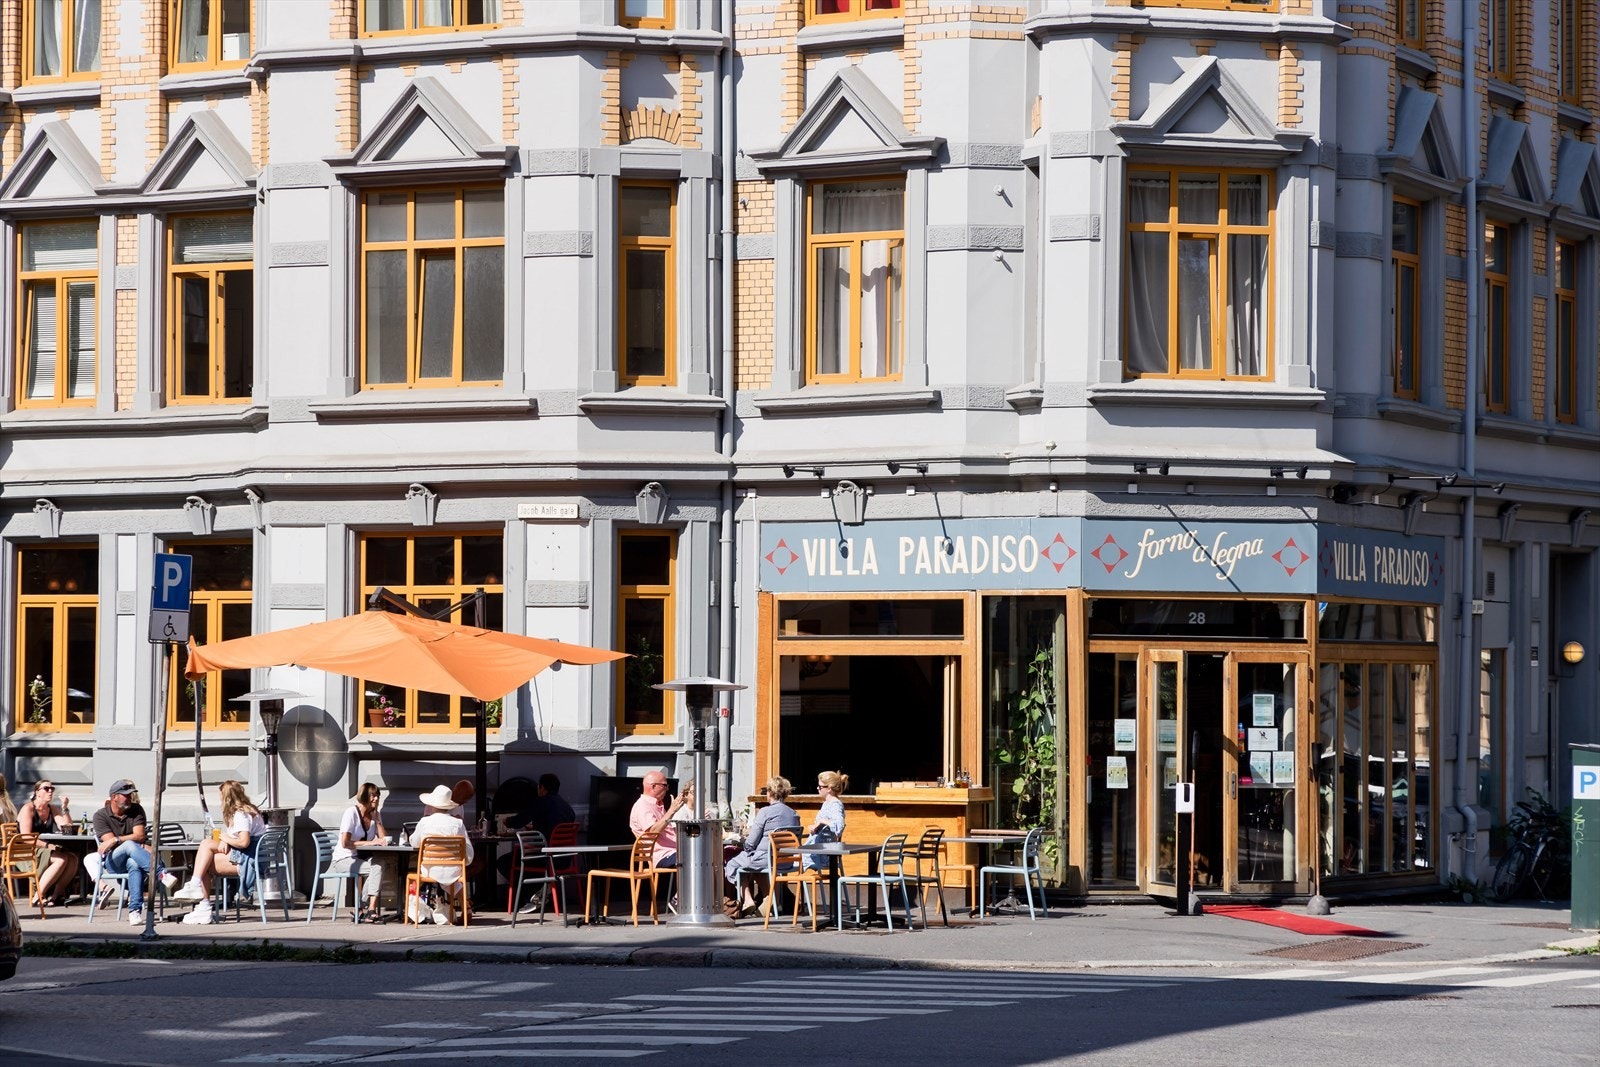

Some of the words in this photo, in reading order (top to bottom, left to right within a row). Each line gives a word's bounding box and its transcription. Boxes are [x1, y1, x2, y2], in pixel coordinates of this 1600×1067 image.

[802, 537, 879, 576] VILLA
[898, 534, 1040, 575] PARADISO
[1124, 527, 1198, 579] forno
[1192, 543, 1207, 564] a
[1210, 531, 1264, 581] legna
[1333, 540, 1367, 582] VILLA
[1374, 546, 1430, 587] PARADISO
[162, 561, 183, 602] P
[1188, 611, 1206, 625] 28
[1580, 772, 1597, 793] P
